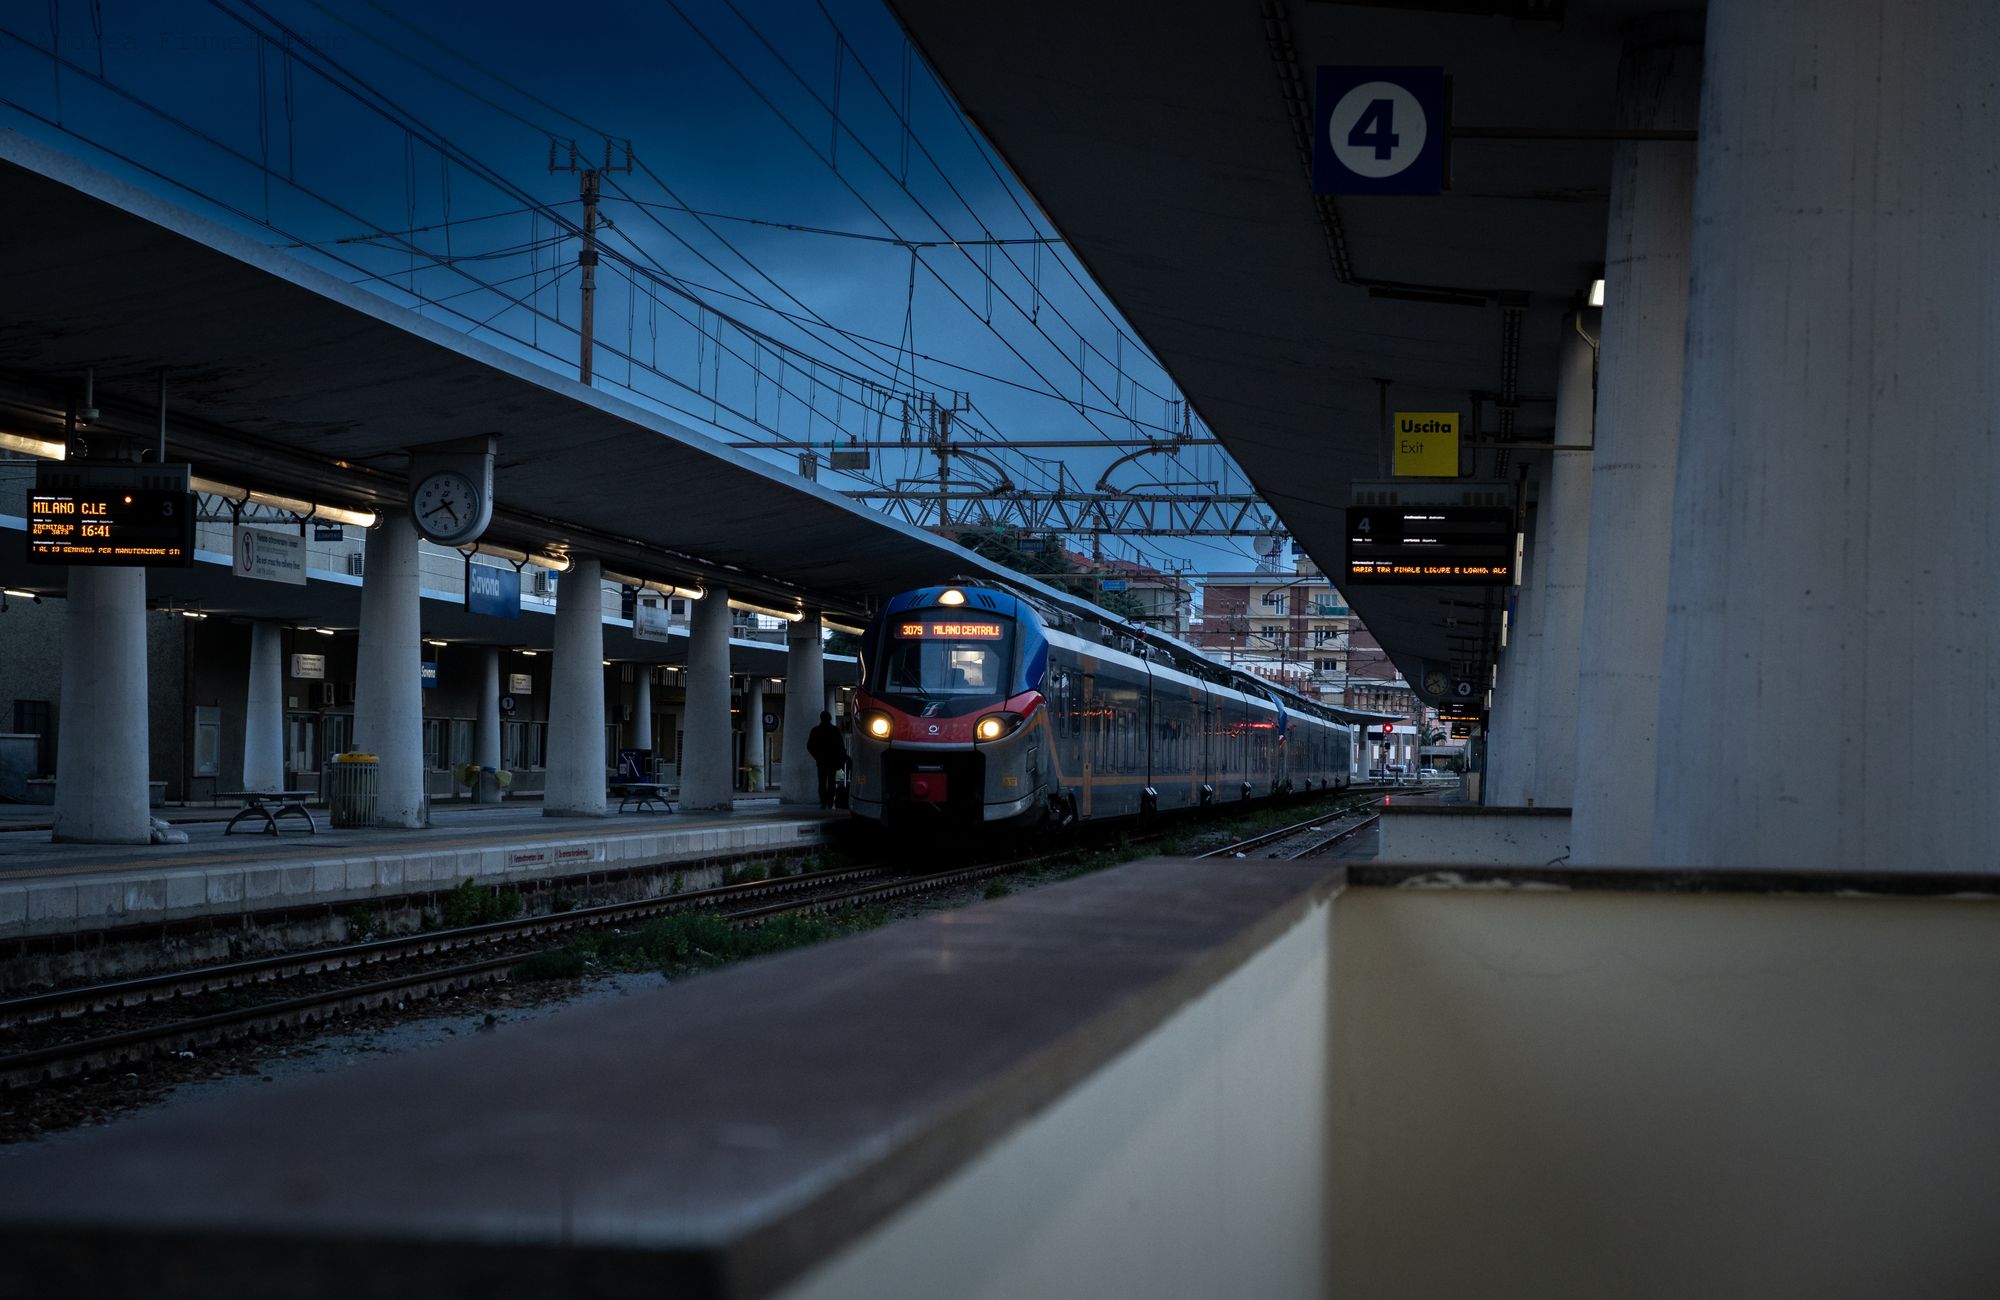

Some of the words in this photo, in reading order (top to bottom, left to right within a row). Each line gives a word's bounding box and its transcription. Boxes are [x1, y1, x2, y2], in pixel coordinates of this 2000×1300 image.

[1348, 99, 1399, 160] 4
[1401, 419, 1452, 433] Uscita
[1401, 440, 1424, 454] Exit
[33, 502, 75, 514] MILANO
[81, 502, 107, 514] C.LE
[162, 501, 174, 517] 3
[81, 525, 110, 537] 16:41
[1358, 517, 1371, 534] 4
[1394, 566, 1421, 574] FINALE
[1424, 566, 1451, 574] LIGURE
[471, 567, 500, 597] Savona
[903, 625, 923, 635] 3079
[934, 625, 961, 635] MILANO
[961, 625, 1000, 635] CENTRALE
[1461, 685, 1467, 693] 4
